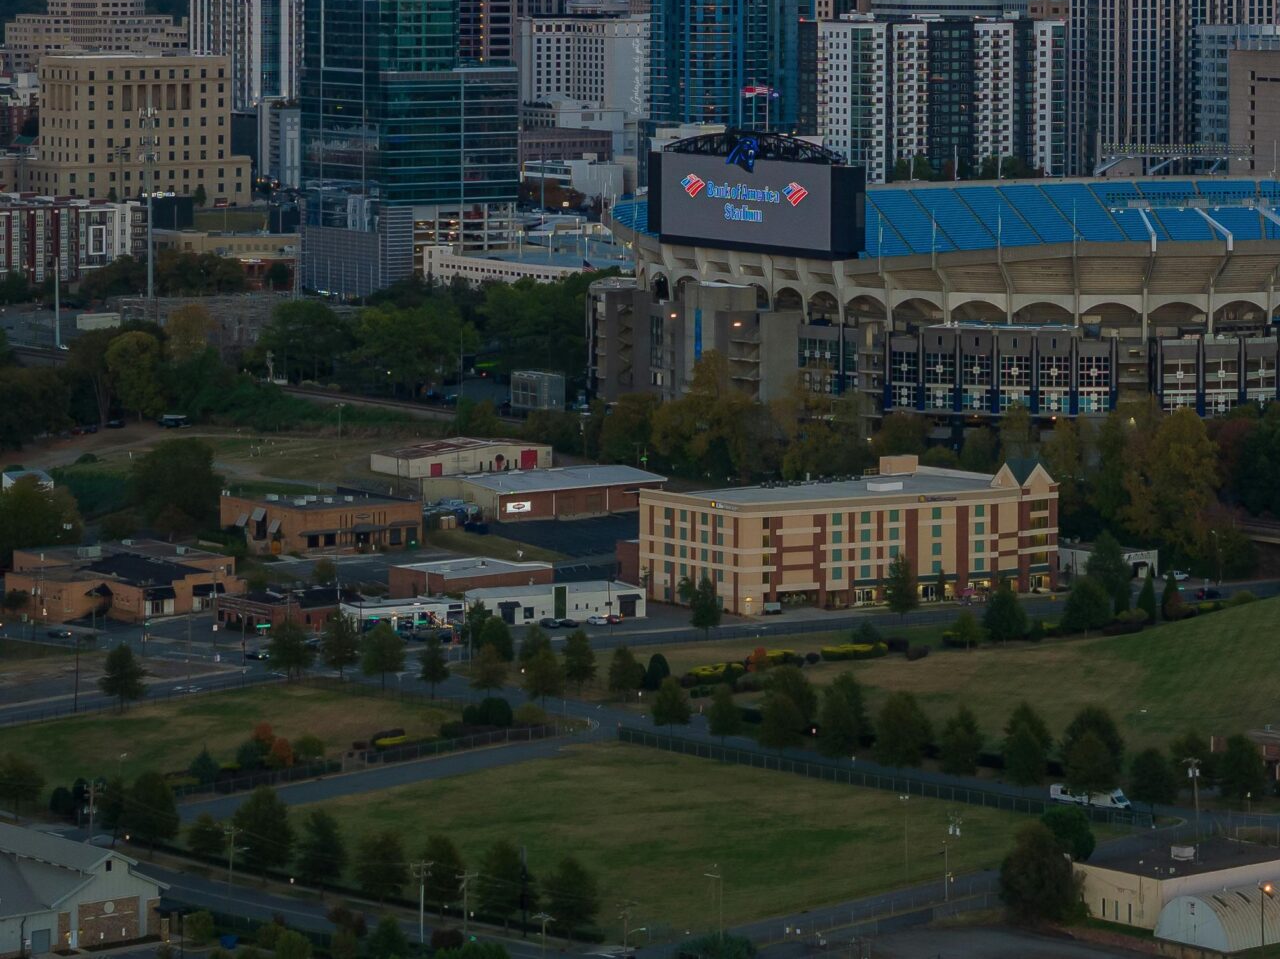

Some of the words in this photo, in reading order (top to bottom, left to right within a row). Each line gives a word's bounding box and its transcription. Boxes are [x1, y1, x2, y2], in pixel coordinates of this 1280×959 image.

[706, 180, 732, 199] Bank
[730, 184, 742, 201] of
[741, 184, 781, 205] America
[724, 202, 764, 223] Stadium
